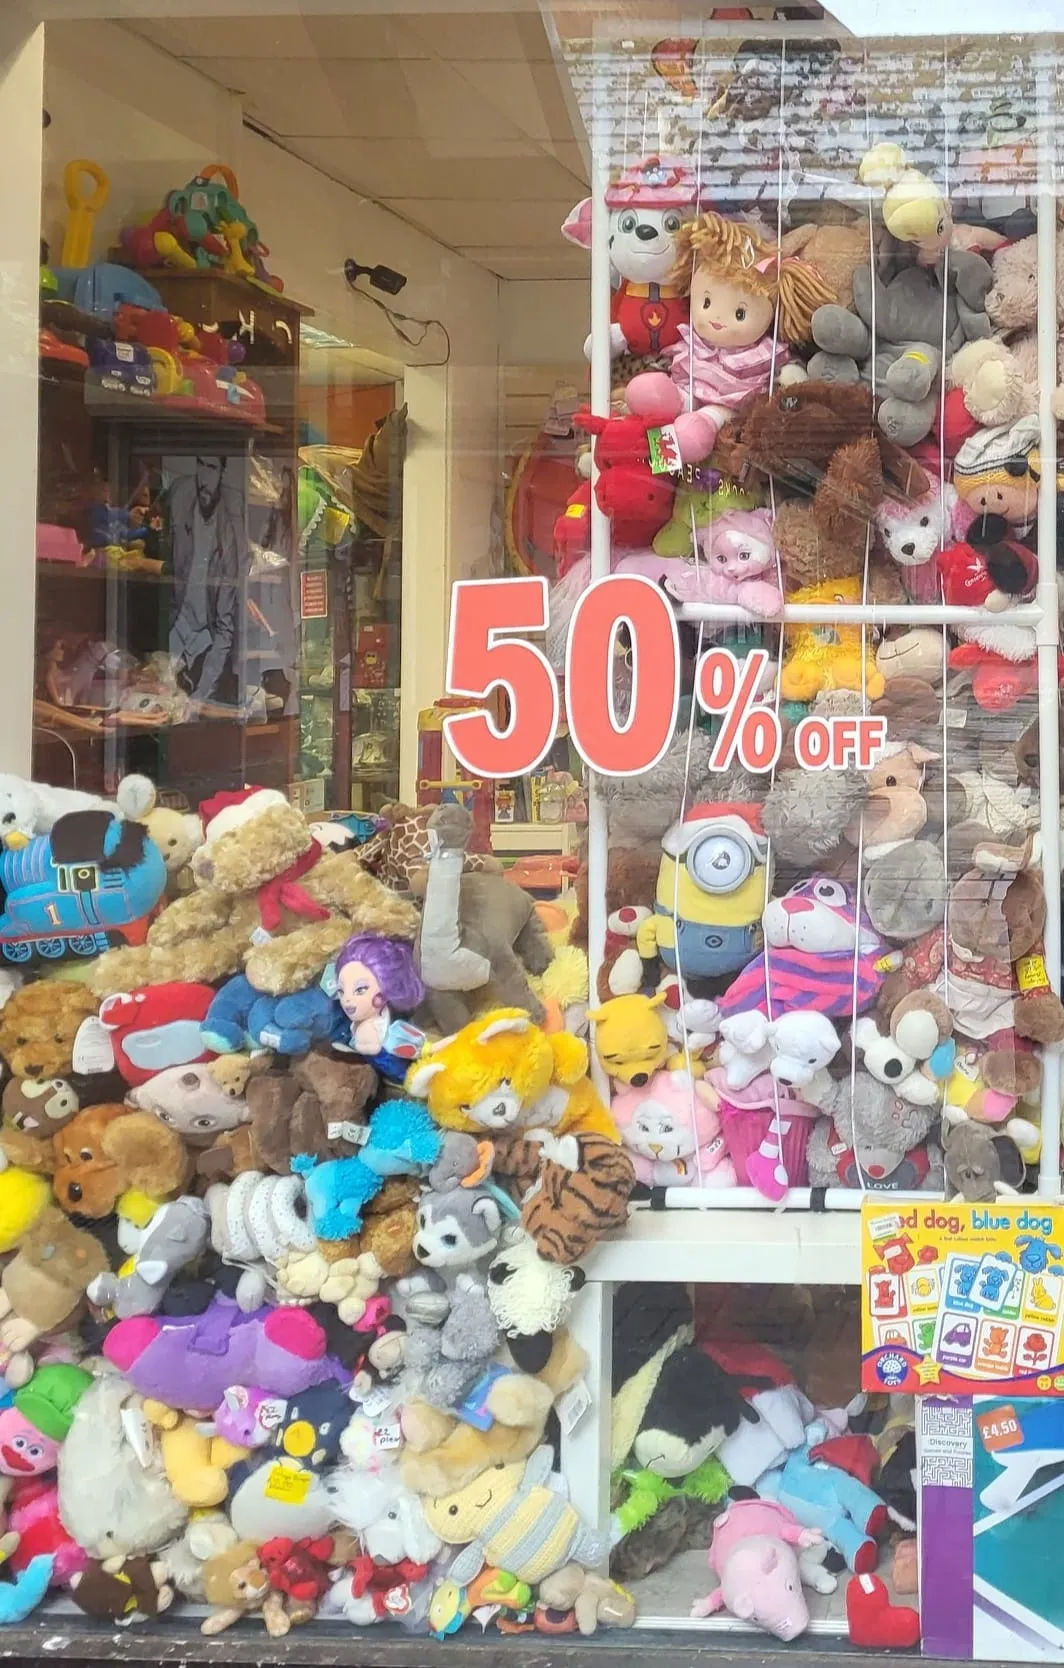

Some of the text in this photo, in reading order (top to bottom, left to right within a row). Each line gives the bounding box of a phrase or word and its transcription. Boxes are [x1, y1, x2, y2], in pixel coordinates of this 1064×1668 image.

[794, 715, 888, 772] OFF
[45, 903, 63, 925] 1
[866, 1181, 899, 1190] LOVE
[897, 1208, 918, 1229] ed
[971, 1208, 1011, 1230] blue
[1016, 1209, 1053, 1236] dog
[877, 1351, 907, 1367] ORCHARD
[982, 1418, 1018, 1440] £4.50
[929, 1438, 967, 1448] Discovery
